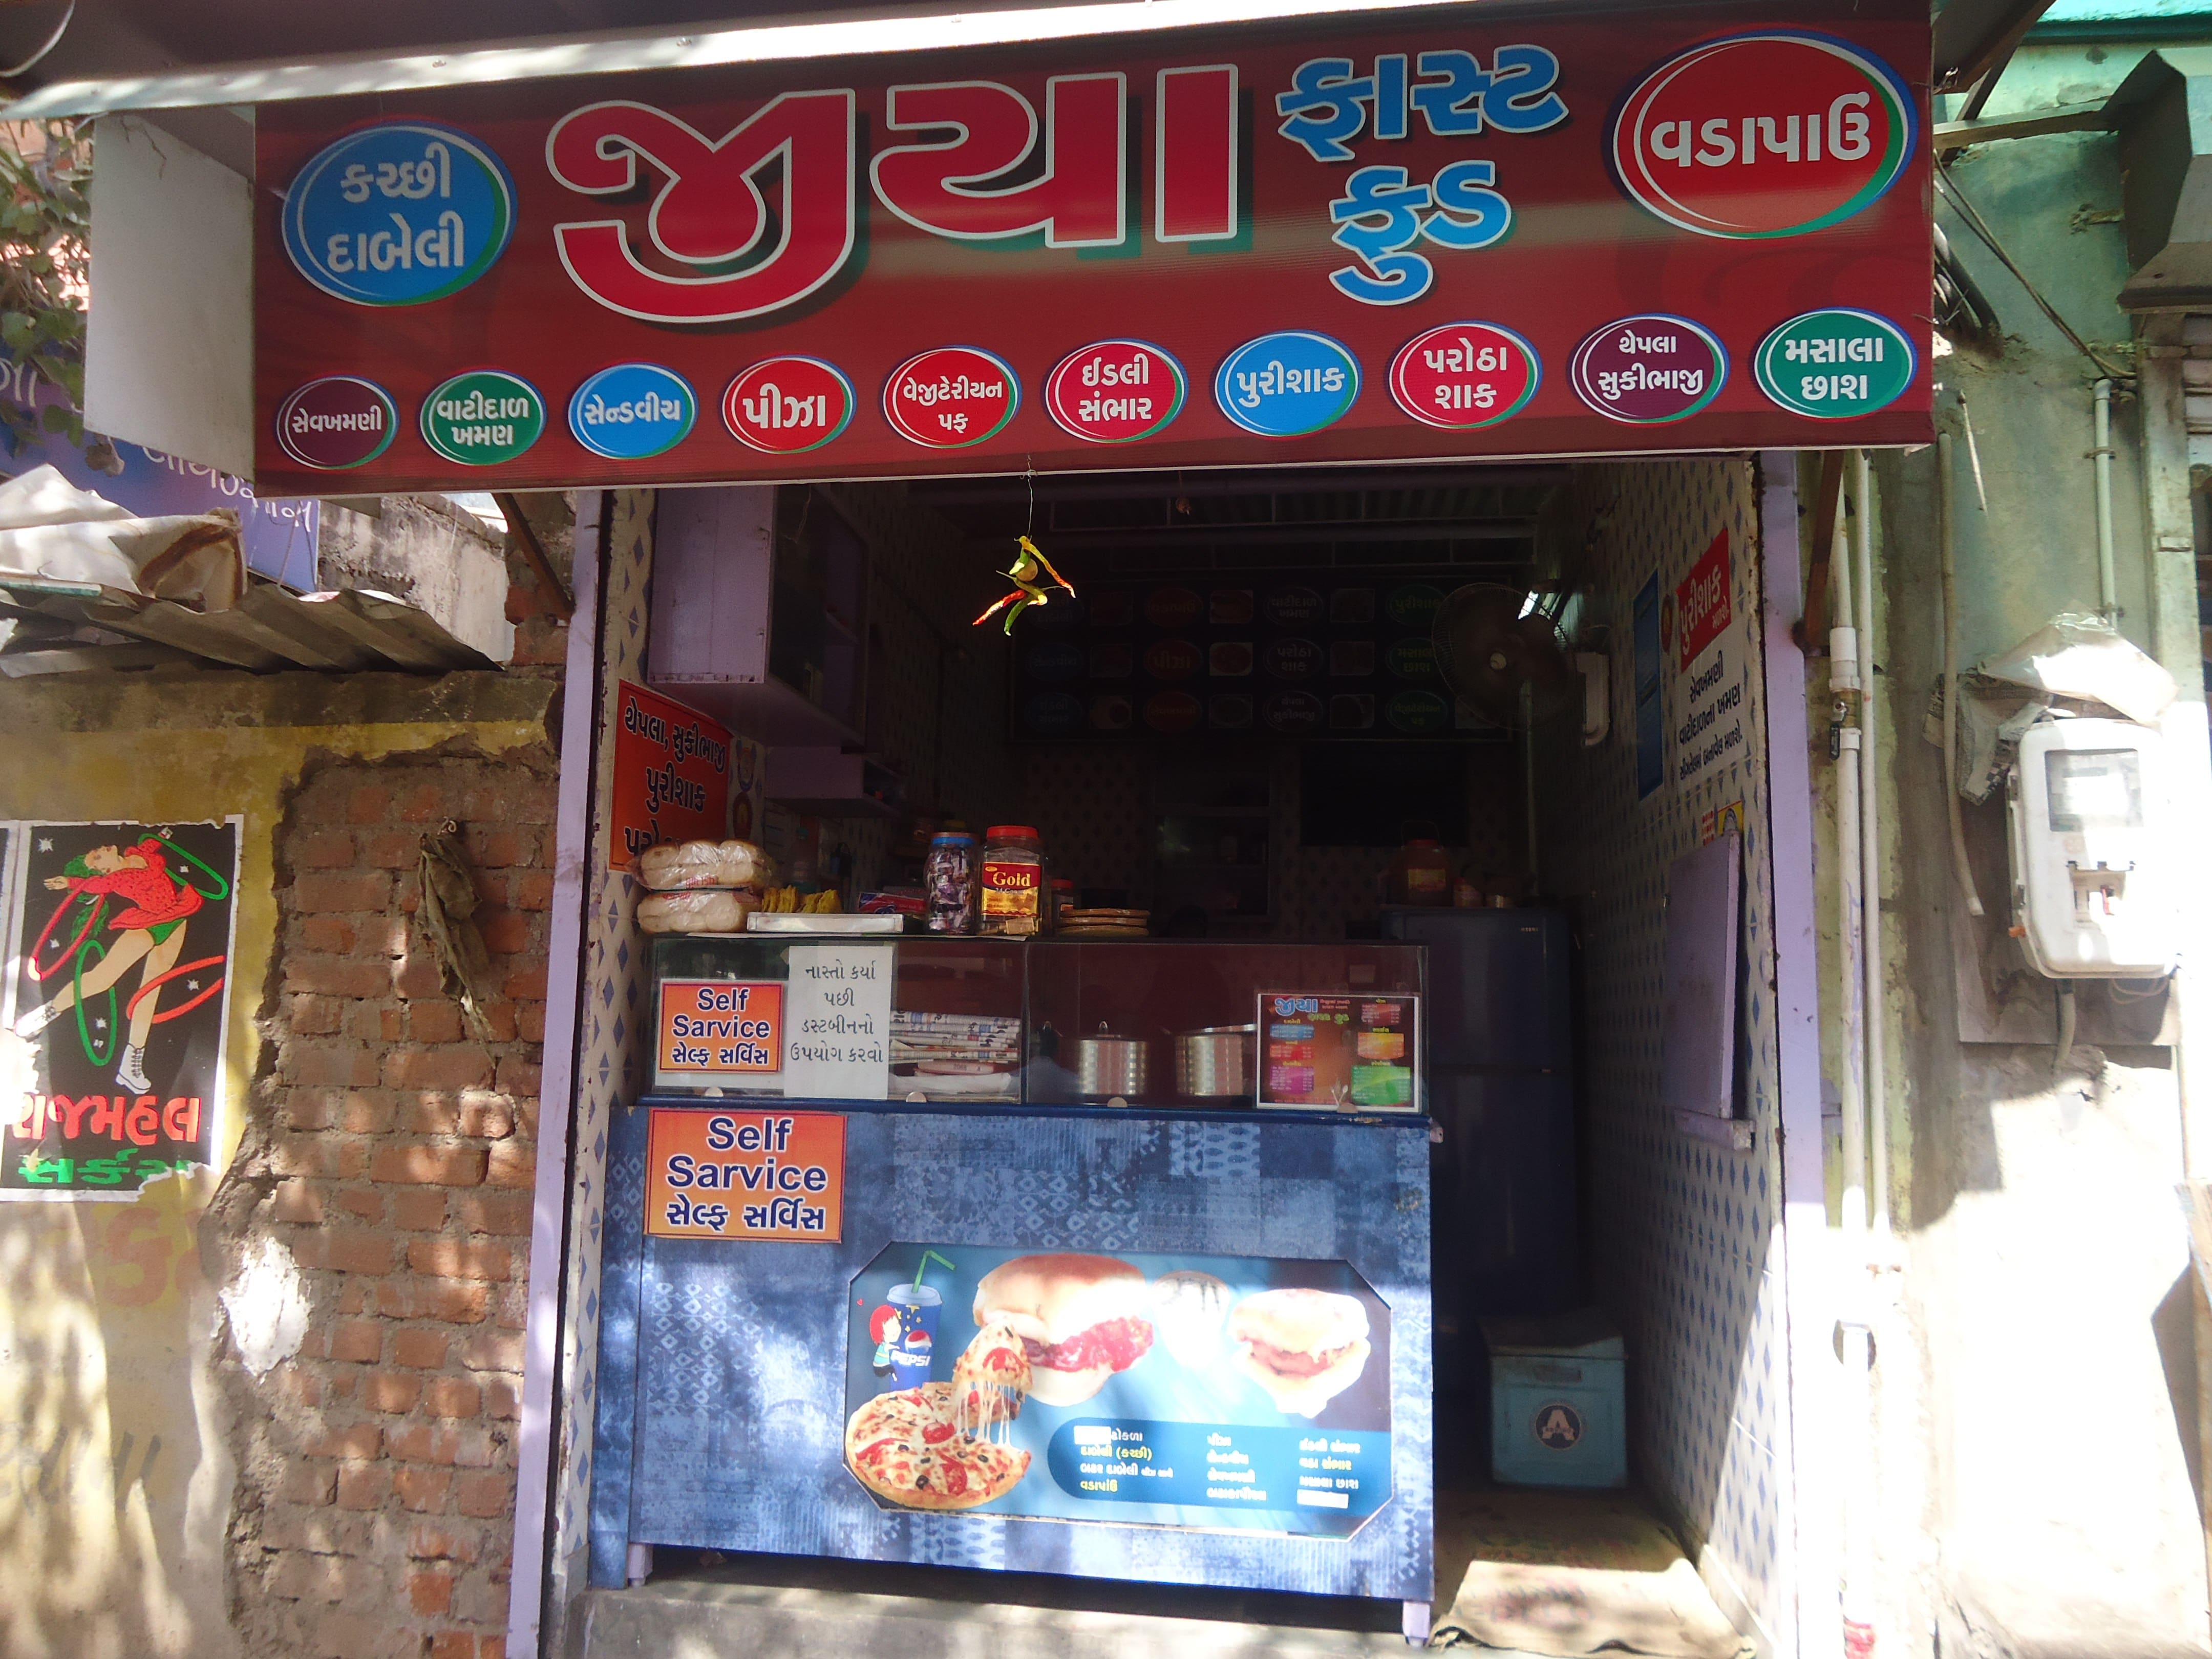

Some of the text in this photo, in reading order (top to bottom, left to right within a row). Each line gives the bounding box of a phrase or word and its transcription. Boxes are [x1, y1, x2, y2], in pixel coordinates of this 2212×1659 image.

[1275, 44, 1569, 162] ફાસ્ટ
[340, 141, 451, 203] કચ્છી
[546, 63, 1238, 324] જીયા
[327, 210, 464, 272] દાબેલી
[1329, 160, 1512, 306] ફુડ
[1423, 337, 1507, 373] પરોઠા
[1619, 329, 1677, 354] થેપલા
[1785, 337, 1884, 364] મસાલા
[1082, 353, 1149, 387] ઈડલી
[1237, 360, 1346, 408] પુરીશાક
[1598, 362, 1704, 401] સુકીભાજી
[903, 375, 1003, 406] વેજીટેરીયન
[1435, 383, 1497, 410] શાક
[1800, 374, 1868, 401] છાશ
[291, 404, 382, 433] સેવખમણી
[436, 390, 529, 420] વાટીદાળ
[584, 391, 681, 425] સેન્ડવીચ
[742, 383, 826, 429] પીઝા
[1079, 390, 1153, 422] સંભાર
[452, 424, 514, 446] ખમણ
[938, 413, 968, 434] પફ
[1680, 564, 1722, 656] પુરીશાક
[1717, 683, 1741, 714] ખમણ
[672, 721, 726, 774] સુકીભાજી
[645, 761, 706, 815] પુરીશાક
[992, 871, 1031, 886] Gold
[805, 959, 877, 980] નાસ્તો કર્યા
[697, 988, 750, 1011] Self
[824, 987, 855, 1006] પછી
[672, 1014, 771, 1038] Sarvice
[802, 1013, 874, 1034] ડસ્ટબીનનો
[672, 1040, 769, 1067] સેલ્ફ સર્વિસ
[791, 1040, 883, 1063] ઉપયોગ કરવો
[706, 1116, 794, 1152] Self
[666, 1154, 828, 1193] Sarvice
[665, 1193, 826, 1233] સેલ્ફ સર્વિસ
[890, 1350, 931, 1367] PEPSI
